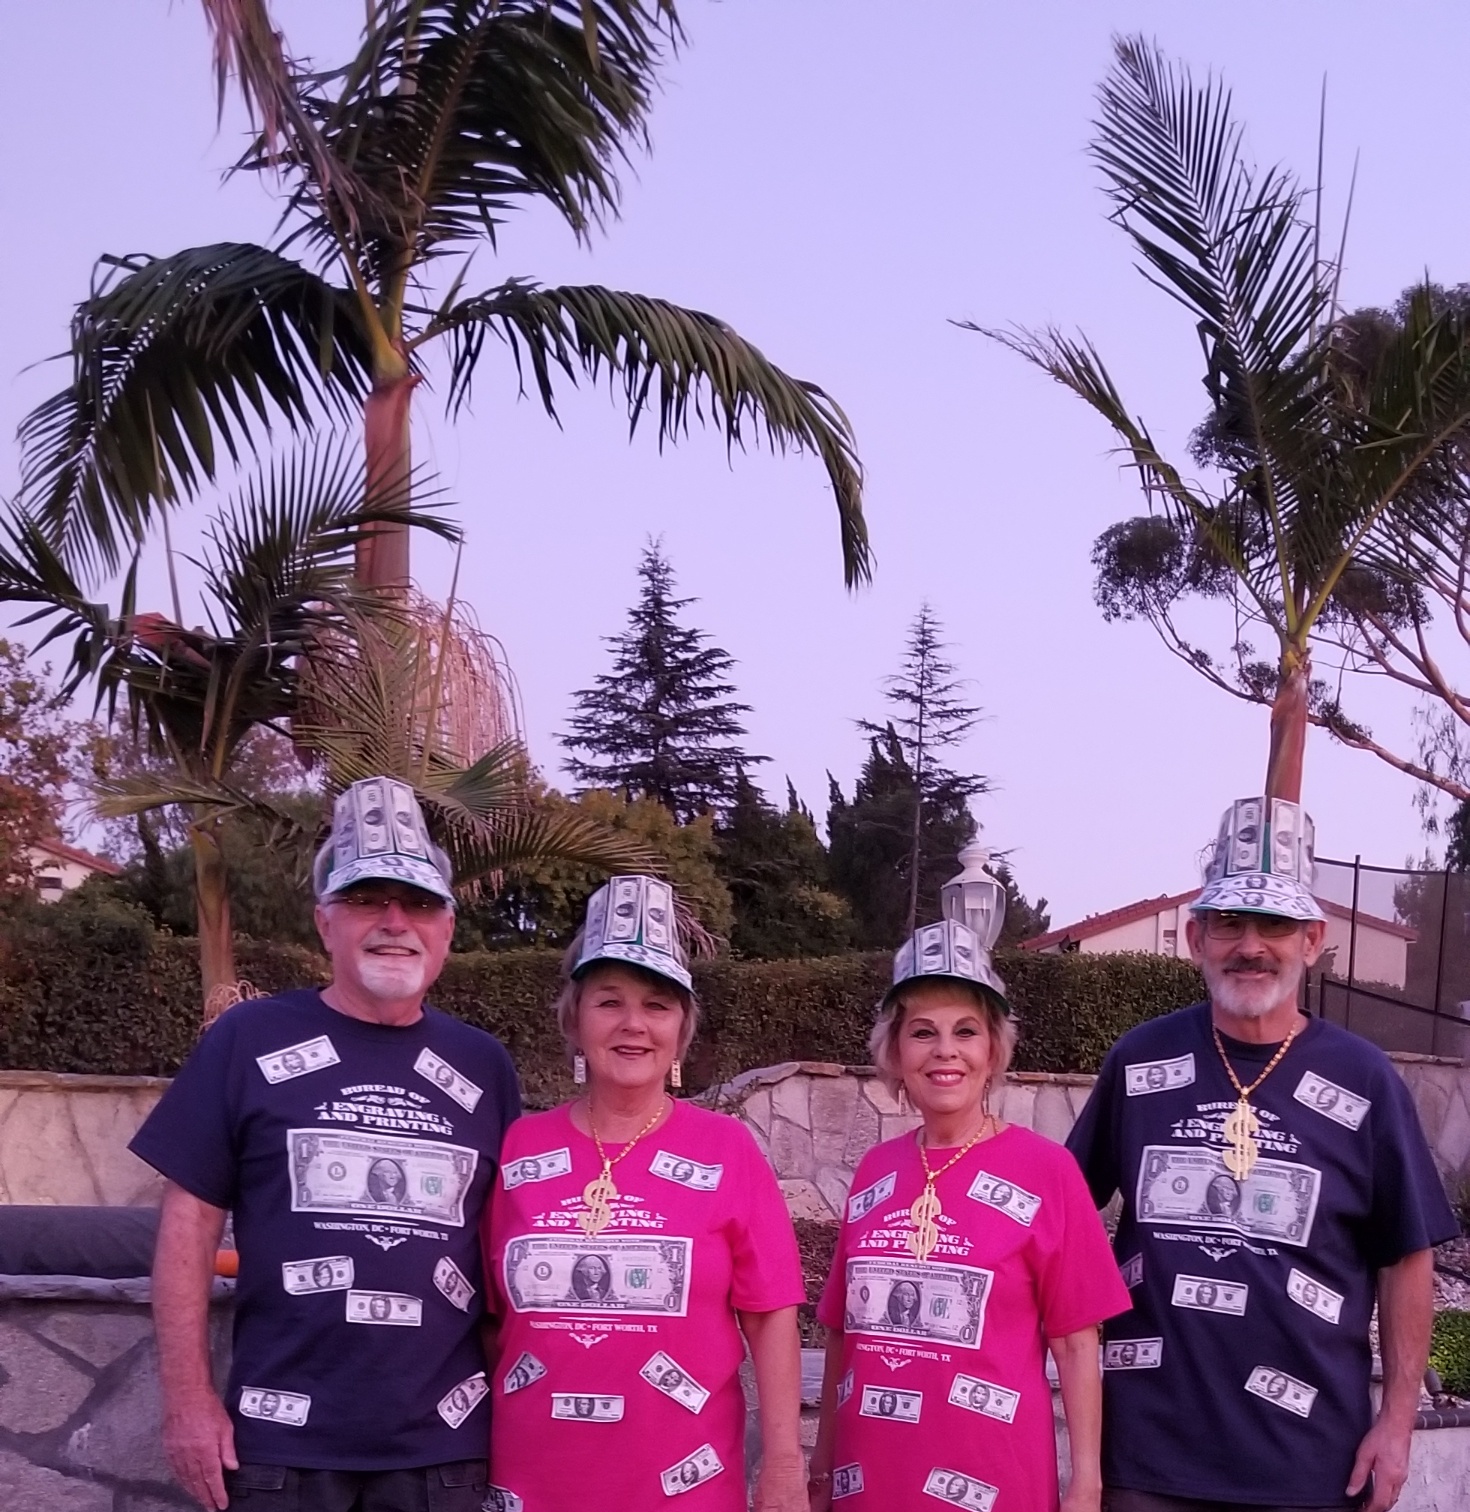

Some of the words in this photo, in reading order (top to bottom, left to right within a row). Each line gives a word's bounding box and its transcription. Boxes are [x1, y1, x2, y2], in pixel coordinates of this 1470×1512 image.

[340, 1084, 406, 1096] BUREAU
[332, 1102, 440, 1123] ENGRAVING
[317, 1112, 358, 1122] AND
[362, 1115, 453, 1135] PRINTING
[1170, 1128, 1207, 1138] AND
[532, 1220, 570, 1228] AND
[858, 1240, 888, 1248] AND
[592, 1323, 613, 1332] FORT
[893, 1327, 927, 1336] DOLLAR
[899, 1348, 917, 1356] FORT
[941, 1354, 951, 1362] TX
